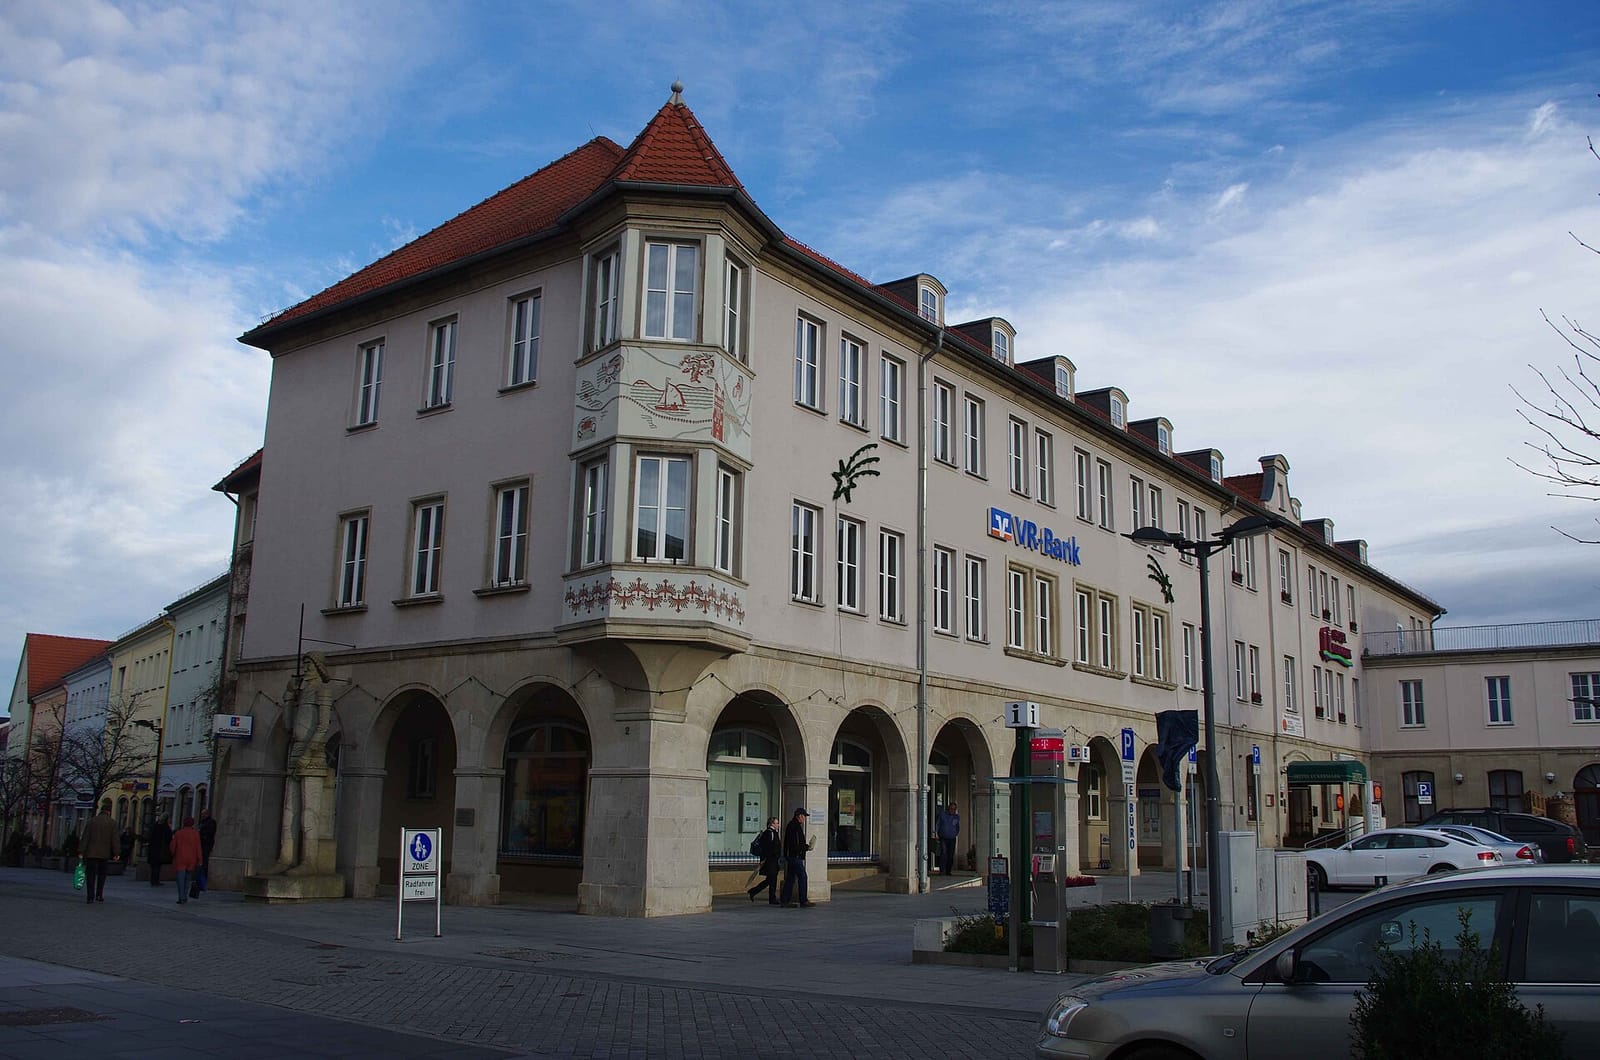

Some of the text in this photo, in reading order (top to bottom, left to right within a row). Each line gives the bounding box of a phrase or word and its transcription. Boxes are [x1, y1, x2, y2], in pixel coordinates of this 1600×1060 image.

[1123, 733, 1133, 756] P
[1254, 747, 1260, 762] P
[1419, 784, 1427, 796] P
[412, 862, 430, 871] ZONE
[405, 880, 435, 888] Radfahrer
[414, 889, 425, 897] frei
